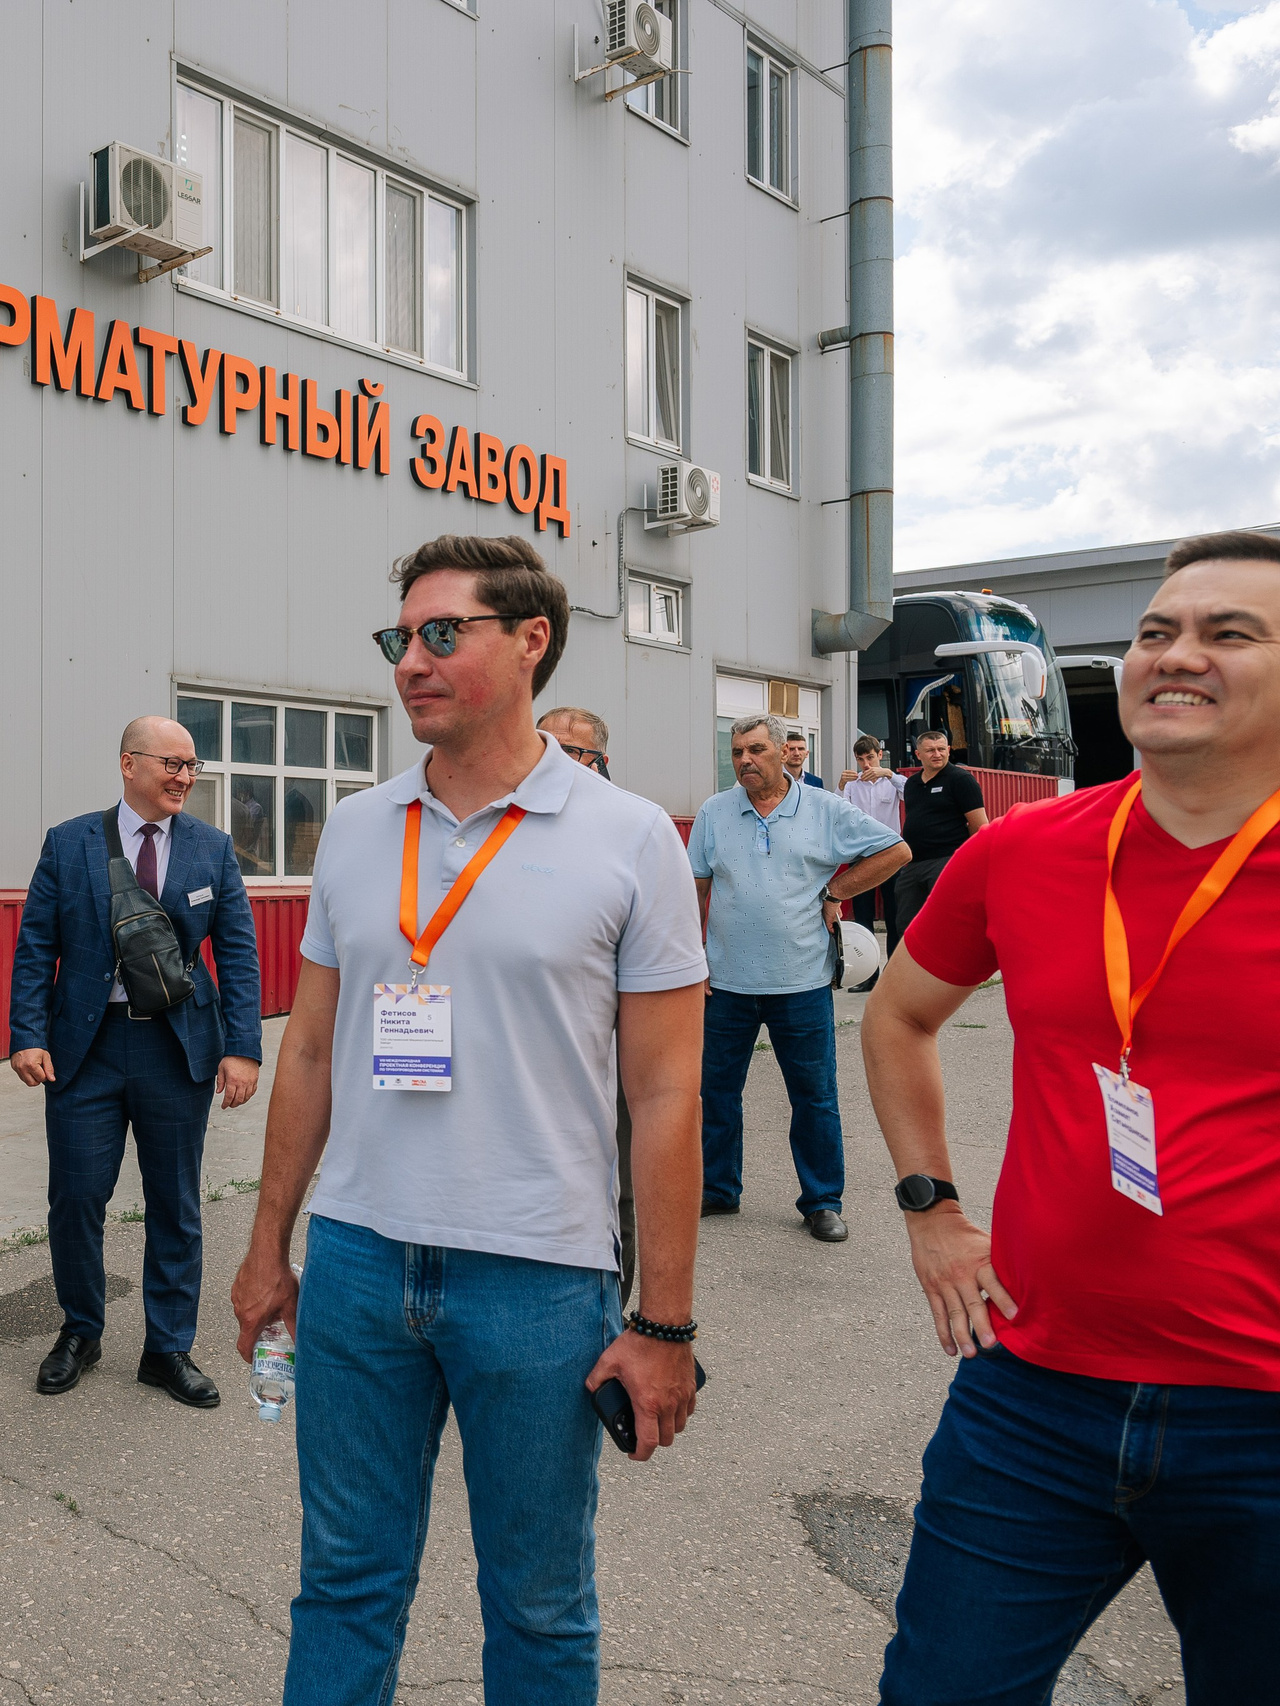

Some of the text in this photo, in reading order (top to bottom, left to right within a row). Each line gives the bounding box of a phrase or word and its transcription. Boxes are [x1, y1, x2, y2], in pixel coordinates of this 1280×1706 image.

[177, 190, 201, 205] LESSAR
[409, 413, 571, 538] ЗАВОД
[380, 1009, 417, 1017] Фетисов
[380, 1026, 434, 1035] Геннадьевич
